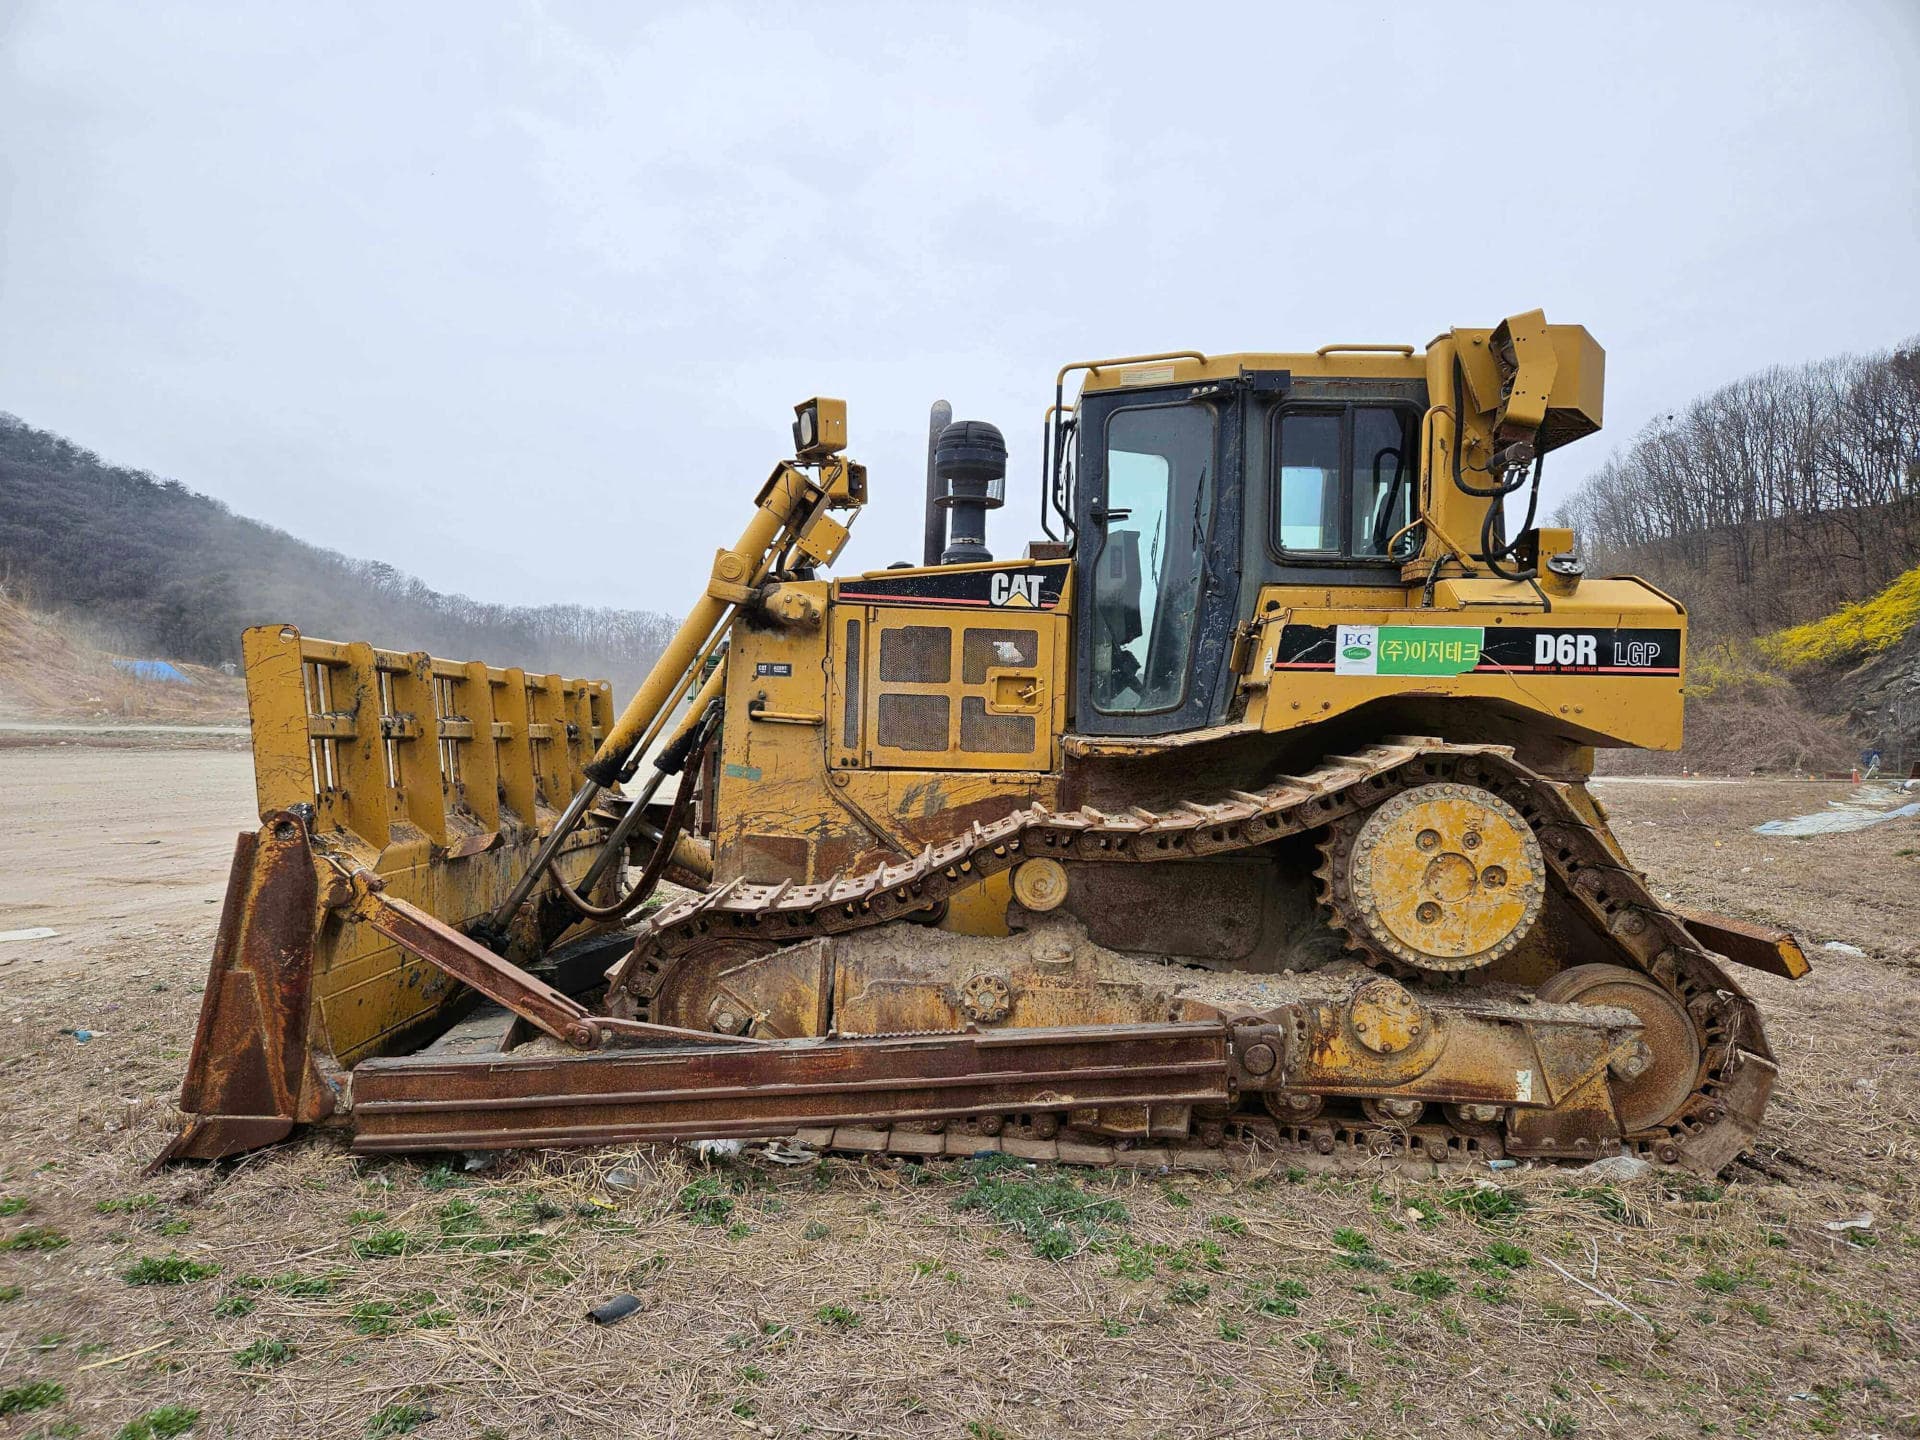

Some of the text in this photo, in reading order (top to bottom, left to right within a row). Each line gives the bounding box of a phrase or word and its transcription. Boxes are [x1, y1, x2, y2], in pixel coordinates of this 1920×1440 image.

[991, 572, 1044, 607] CAT
[1343, 633, 1372, 646] EG
[1379, 640, 1480, 663] (주)이지테크
[1534, 633, 1660, 666] D6R LGP
